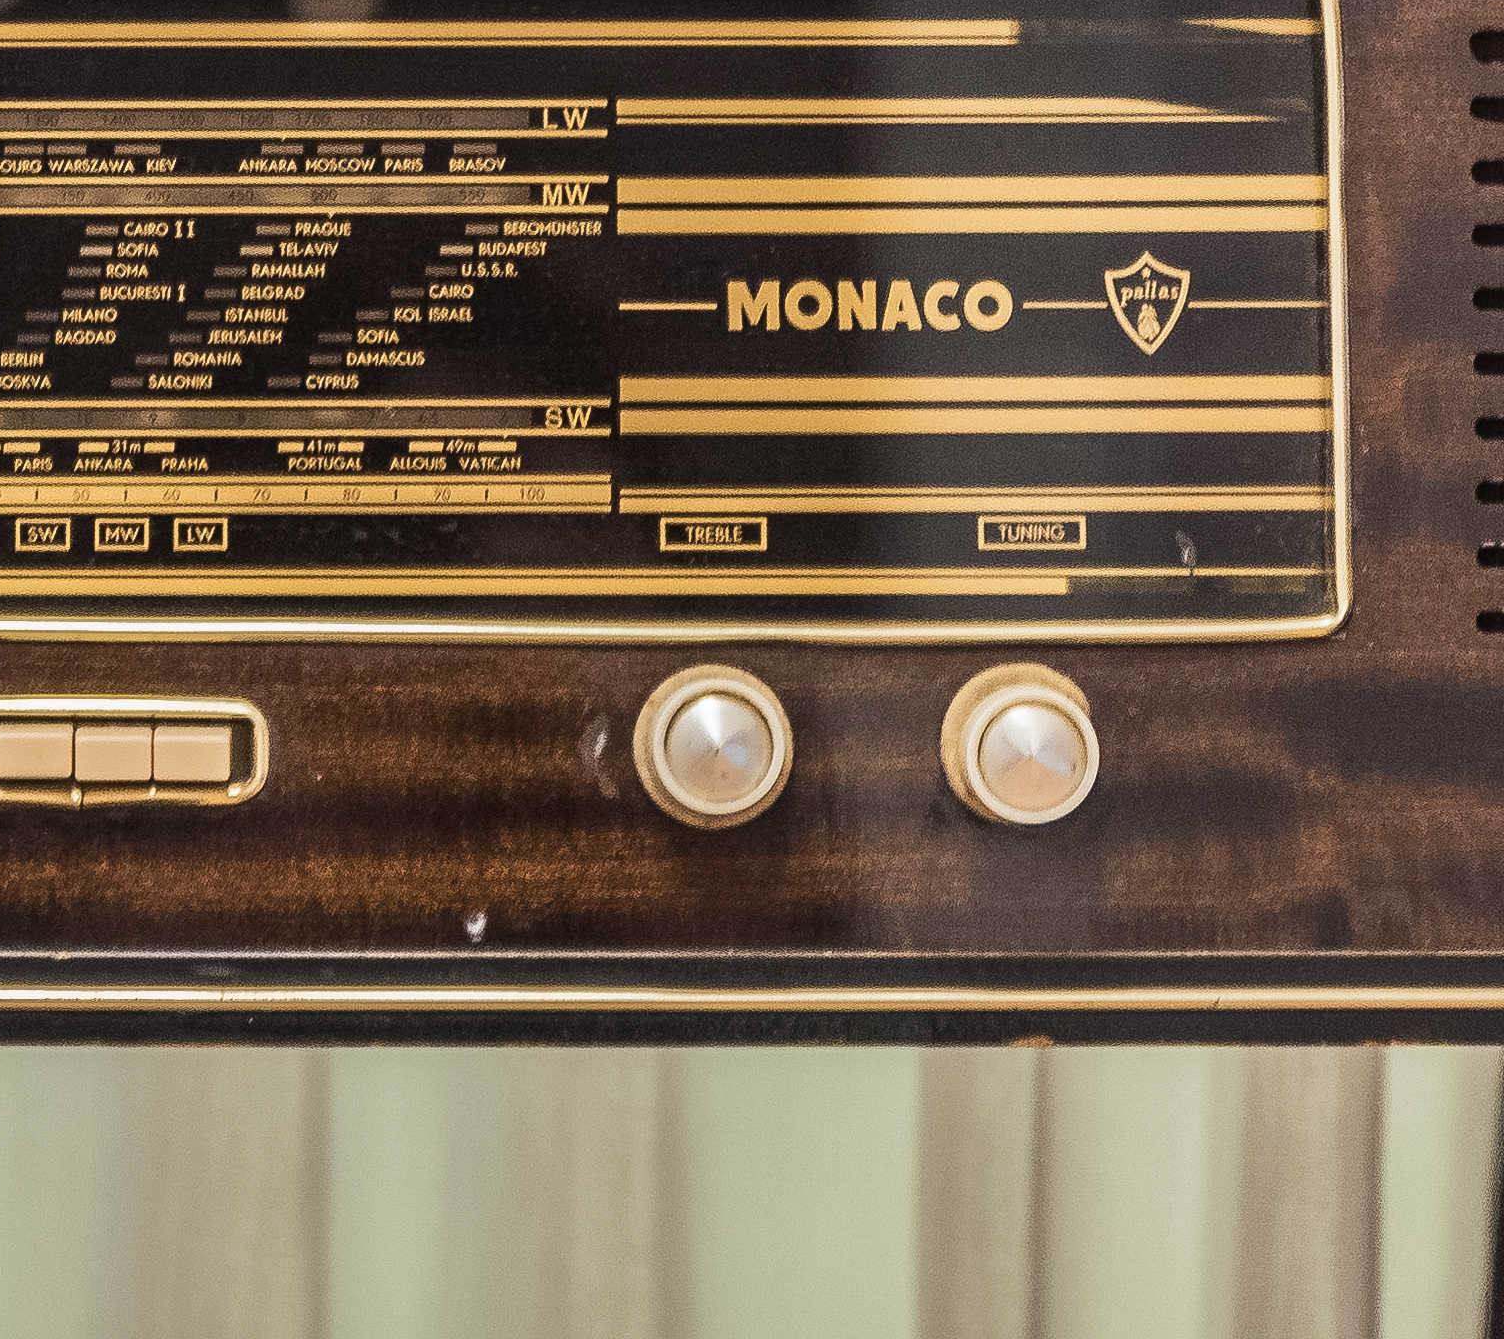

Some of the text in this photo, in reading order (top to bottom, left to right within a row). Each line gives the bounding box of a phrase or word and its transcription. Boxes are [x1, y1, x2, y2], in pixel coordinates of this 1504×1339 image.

[542, 107, 589, 130] LW
[47, 158, 135, 174] WARSZAWA
[146, 157, 177, 173] KIEV
[238, 158, 298, 173] ANKARA
[305, 157, 376, 173] MOSCOW
[384, 157, 424, 173] PARIS
[448, 157, 507, 173] BRASOV
[542, 183, 590, 205] MW
[123, 221, 169, 237] CAIRO
[294, 221, 351, 237] PRAGUE
[117, 242, 159, 257] SOFIA
[478, 240, 548, 257] BUDAPEST
[105, 262, 149, 278] ROMA
[251, 262, 326, 278] RAMALLAH
[241, 284, 306, 301] BELGRAD
[428, 283, 475, 300] CAIRO
[1121, 283, 1180, 303] pallas
[727, 278, 1014, 333] MONACO
[62, 307, 118, 323] MILANO
[224, 307, 289, 323] ISTANBUL
[393, 306, 474, 323] KOL ISRAEL
[54, 329, 117, 345] BAGDAD
[207, 328, 283, 345] JERUSALEM
[356, 328, 400, 344] SOFIA
[0, 352, 44, 368] BERLIN
[173, 351, 243, 367] ROMANIA
[346, 350, 426, 367] DAMASCUS
[148, 373, 213, 390] SALONIKI
[305, 373, 360, 390] CYPRUS
[544, 407, 592, 429] SW
[307, 441, 336, 454] 41m
[13, 456, 53, 472] PARIS
[73, 457, 133, 472] ANKARA
[161, 457, 209, 471] PRAHA
[287, 456, 362, 471] PORTUGAL
[389, 456, 447, 471] ALLOUIS
[458, 456, 522, 471] VATICAN
[26, 526, 58, 543] SW
[104, 526, 139, 543] MW
[187, 526, 214, 542] LW
[685, 524, 743, 545] TREBLE
[998, 523, 1064, 543] TUNING
